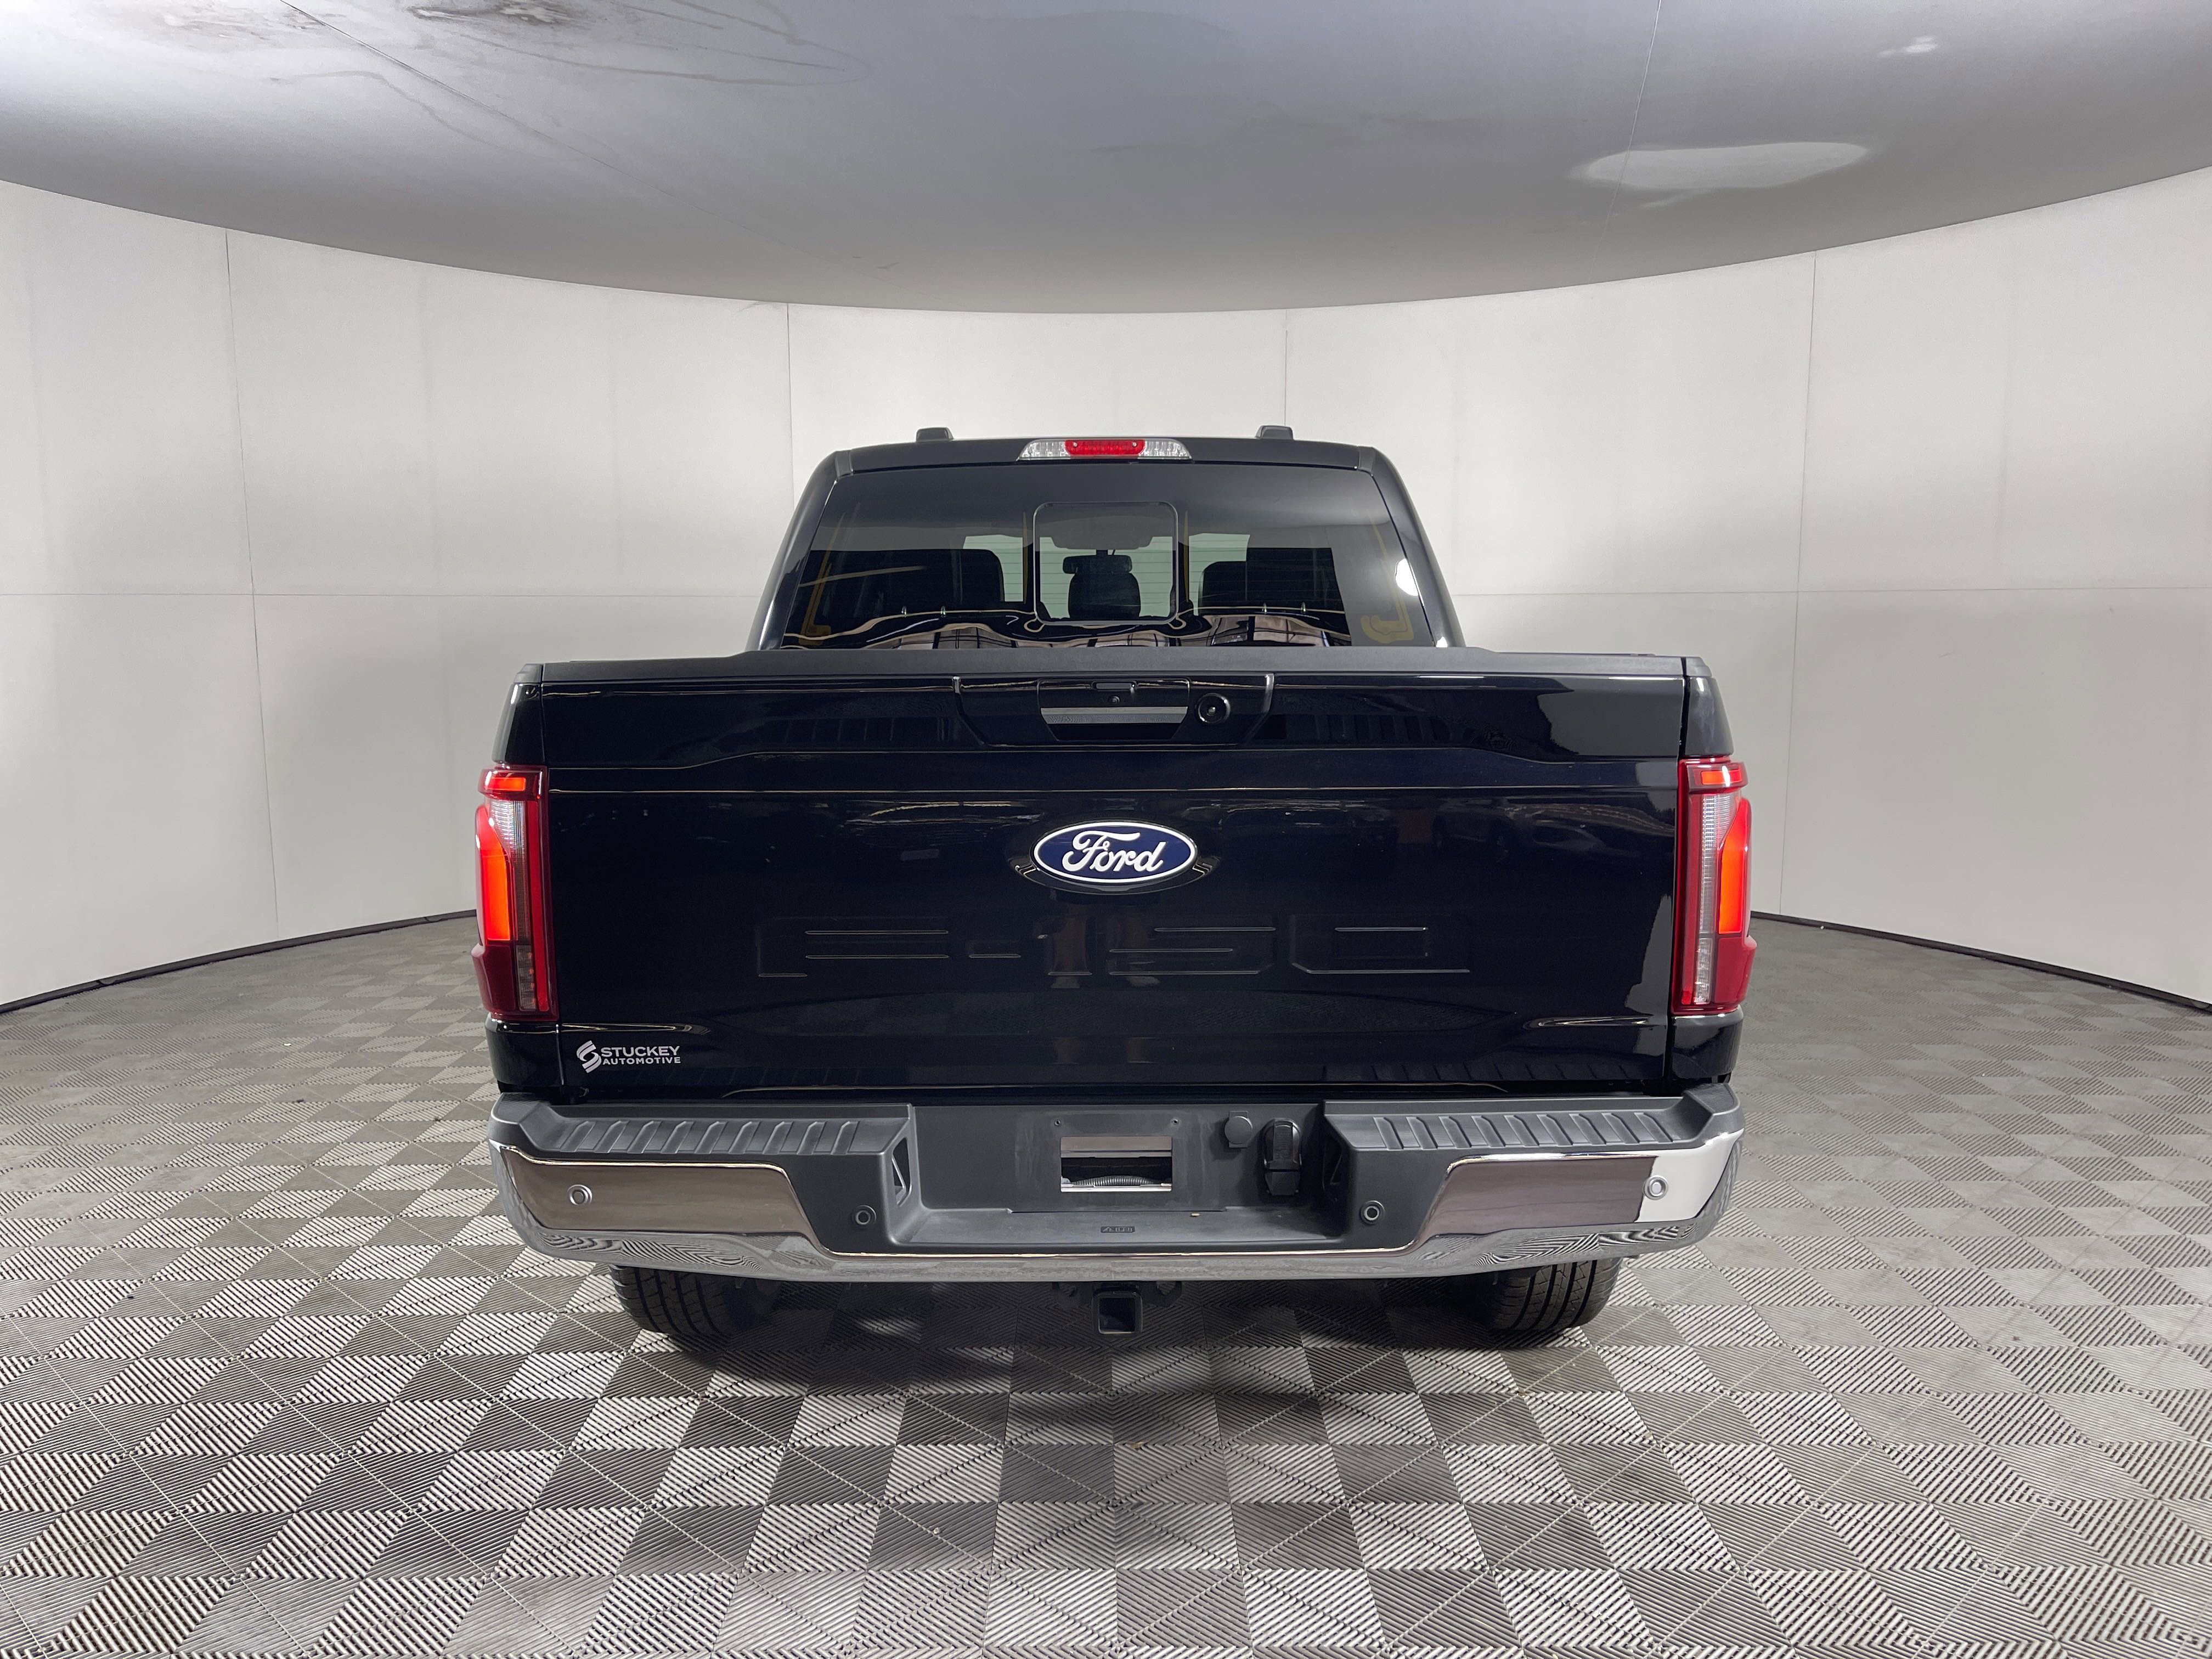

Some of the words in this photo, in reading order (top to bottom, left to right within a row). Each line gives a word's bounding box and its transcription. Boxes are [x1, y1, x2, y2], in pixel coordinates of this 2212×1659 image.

[1062, 830, 1166, 872] Ford
[600, 1046, 680, 1057] STUCKEY
[602, 1057, 681, 1065] AUTOMOTIVE
